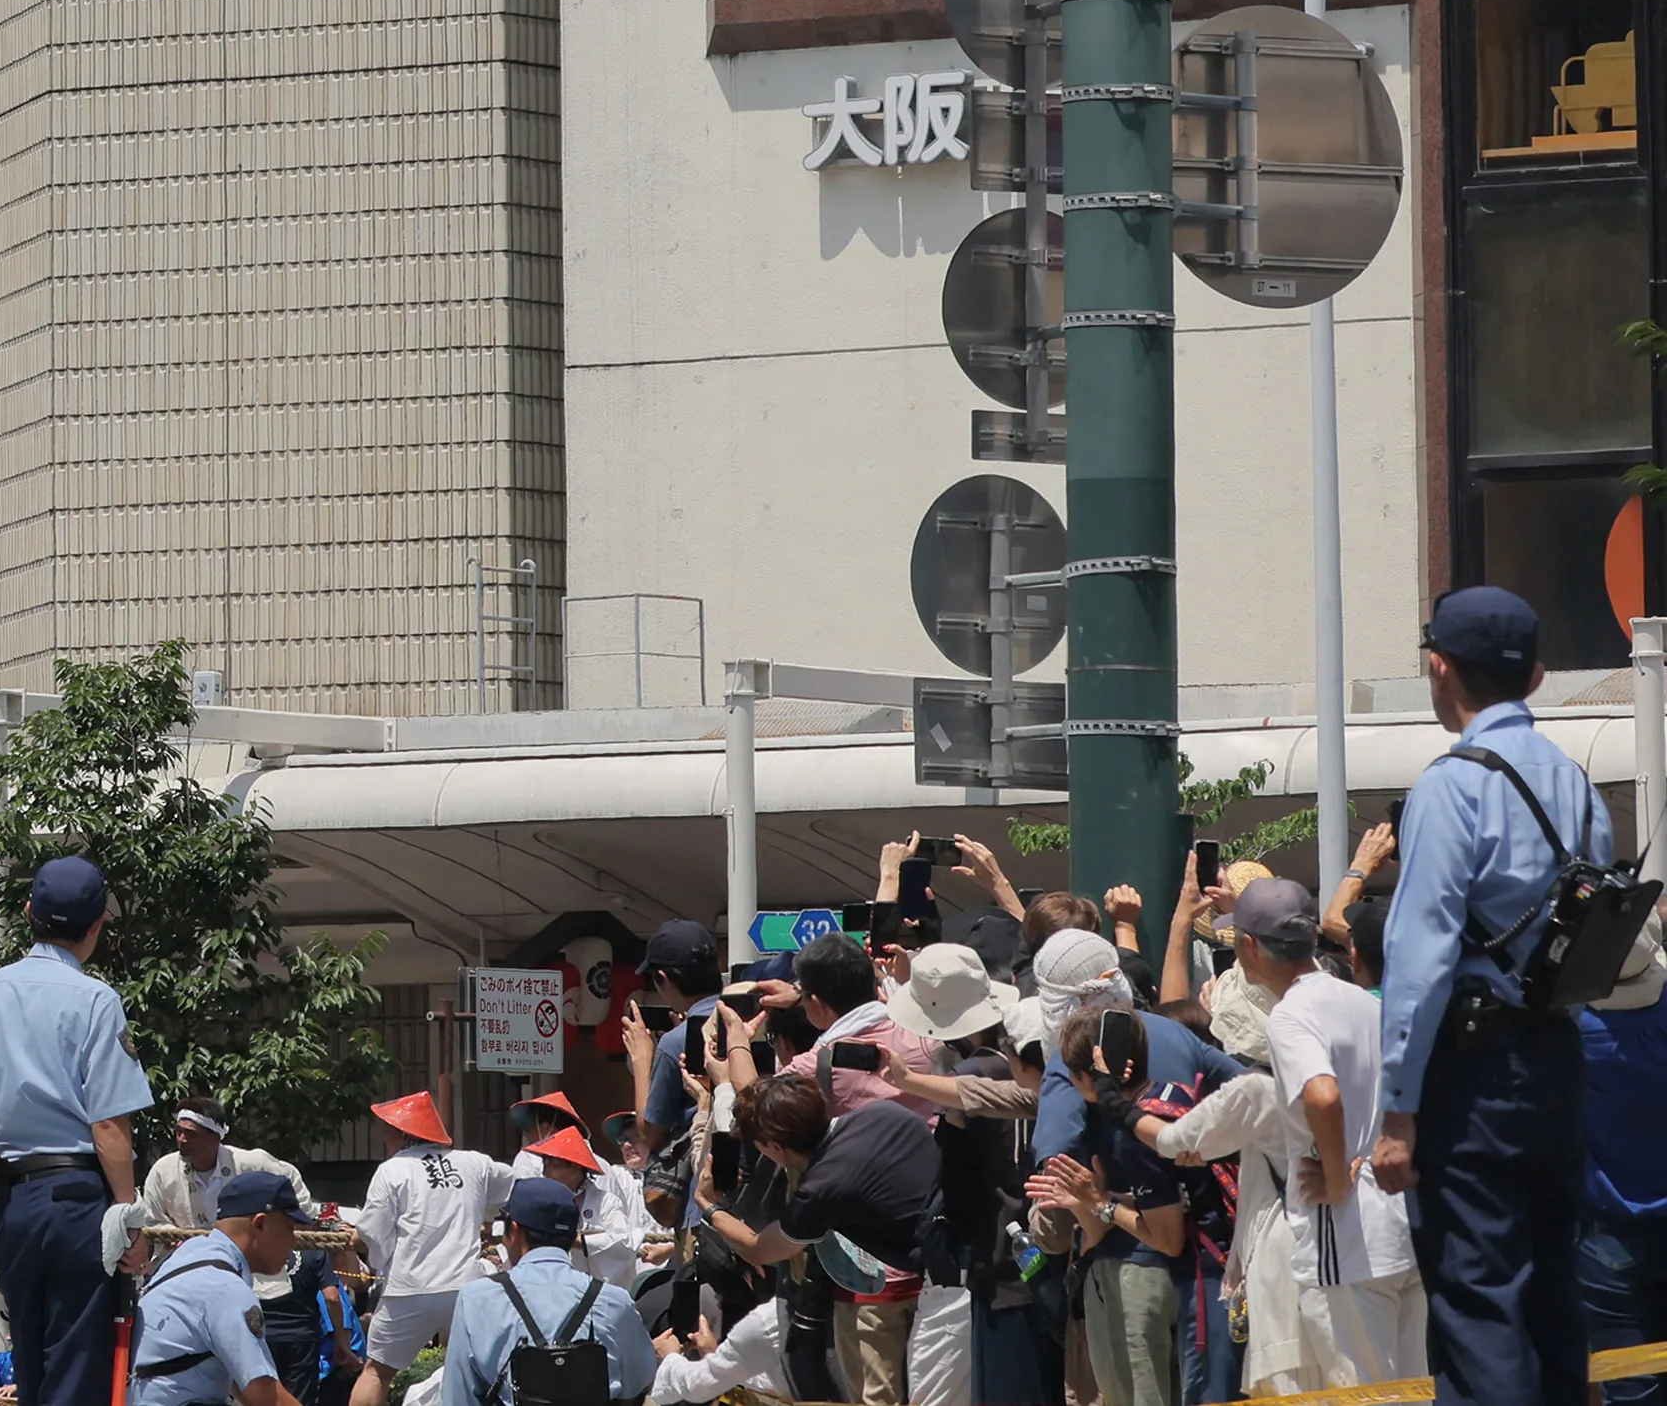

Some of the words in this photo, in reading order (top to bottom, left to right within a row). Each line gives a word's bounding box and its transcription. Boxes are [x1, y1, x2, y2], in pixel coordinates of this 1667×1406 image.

[479, 976, 560, 997] ごみのポイ捨て禁止
[479, 998, 506, 1014] Don't
[507, 1000, 533, 1015] Litter
[505, 1039, 529, 1054] 버리지
